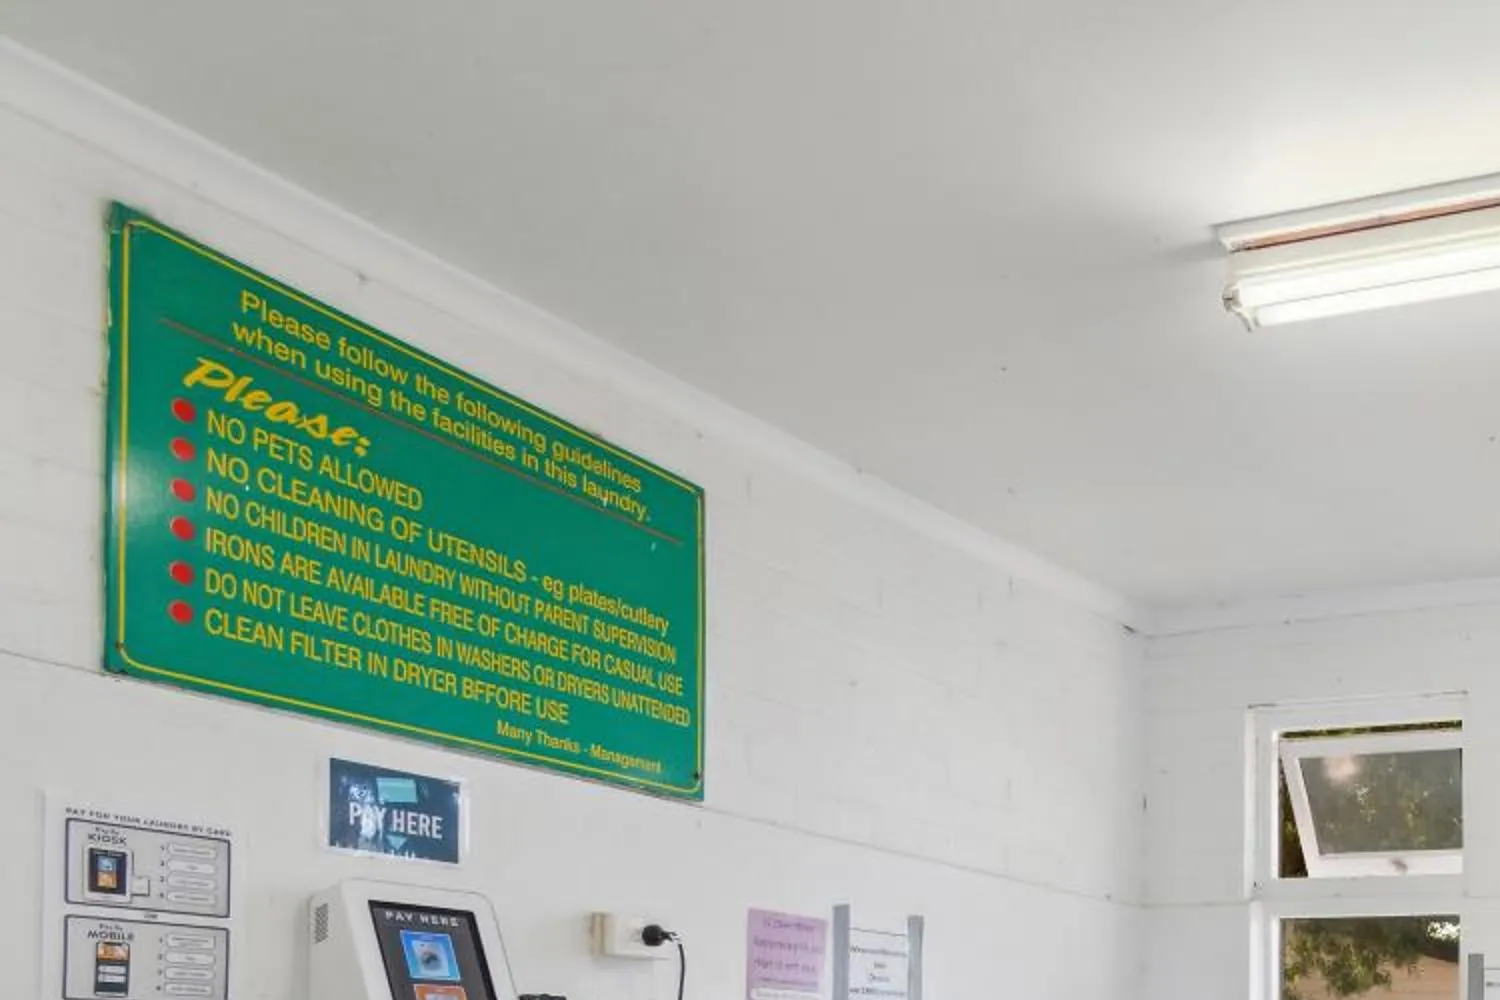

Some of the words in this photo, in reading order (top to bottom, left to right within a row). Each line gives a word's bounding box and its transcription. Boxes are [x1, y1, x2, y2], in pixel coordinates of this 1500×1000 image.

[183, 356, 371, 457] Please:
[232, 322, 306, 369] when
[315, 359, 383, 407] using
[390, 389, 426, 420] the
[432, 408, 515, 460] facilities
[522, 448, 539, 472] in
[544, 460, 577, 488] this
[241, 289, 330, 350] Please
[338, 337, 408, 384] follow
[415, 373, 449, 404] the
[456, 391, 545, 453] following
[552, 440, 640, 492] guidelines
[207, 409, 246, 445] NO
[253, 427, 312, 471] PETS
[320, 455, 422, 511] ALLOWED
[207, 447, 249, 484] NO
[257, 467, 384, 532] CLEANING
[391, 515, 423, 542] OF
[428, 528, 527, 583] UTENSILS
[543, 574, 564, 600] eg
[206, 486, 239, 520] NO
[245, 501, 346, 555] CHILDREN
[351, 536, 370, 563] IN
[375, 544, 455, 590] LAUNDRY
[459, 572, 531, 615] WITHOUT
[535, 599, 589, 634] PARENT
[592, 619, 677, 664] SUPERVISION
[206, 527, 275, 571] IRONS
[280, 552, 321, 584] ARE
[326, 567, 425, 617] AVAILABLE
[429, 598, 474, 632] FREE
[478, 612, 501, 638] OF
[504, 622, 569, 661] CHARGE
[572, 642, 601, 669] FOR
[604, 653, 657, 688] CASUAL
[658, 672, 684, 697] USE
[204, 608, 284, 651] CLEAN
[290, 629, 362, 671] FILTER
[367, 651, 388, 679] IN
[393, 657, 457, 697] DRYER
[536, 696, 569, 725] USE
[205, 568, 237, 599] DO
[242, 578, 285, 613] NOT
[289, 591, 349, 633] LEAVE
[352, 611, 432, 654] CLOTHES
[437, 636, 453, 661] IN
[456, 640, 531, 682] WASHERS
[533, 664, 554, 688] OR
[556, 669, 611, 705] DRYERS
[611, 686, 691, 728] UNATTENDED
[497, 719, 532, 746] Many
[65, 807, 86, 816] PAY
[87, 833, 127, 846] KIOSK
[350, 801, 387, 834] PAY
[392, 809, 443, 839] HERE
[87, 929, 135, 941] MOBILE
[384, 911, 414, 922] PAY
[420, 912, 459, 927] HERE
